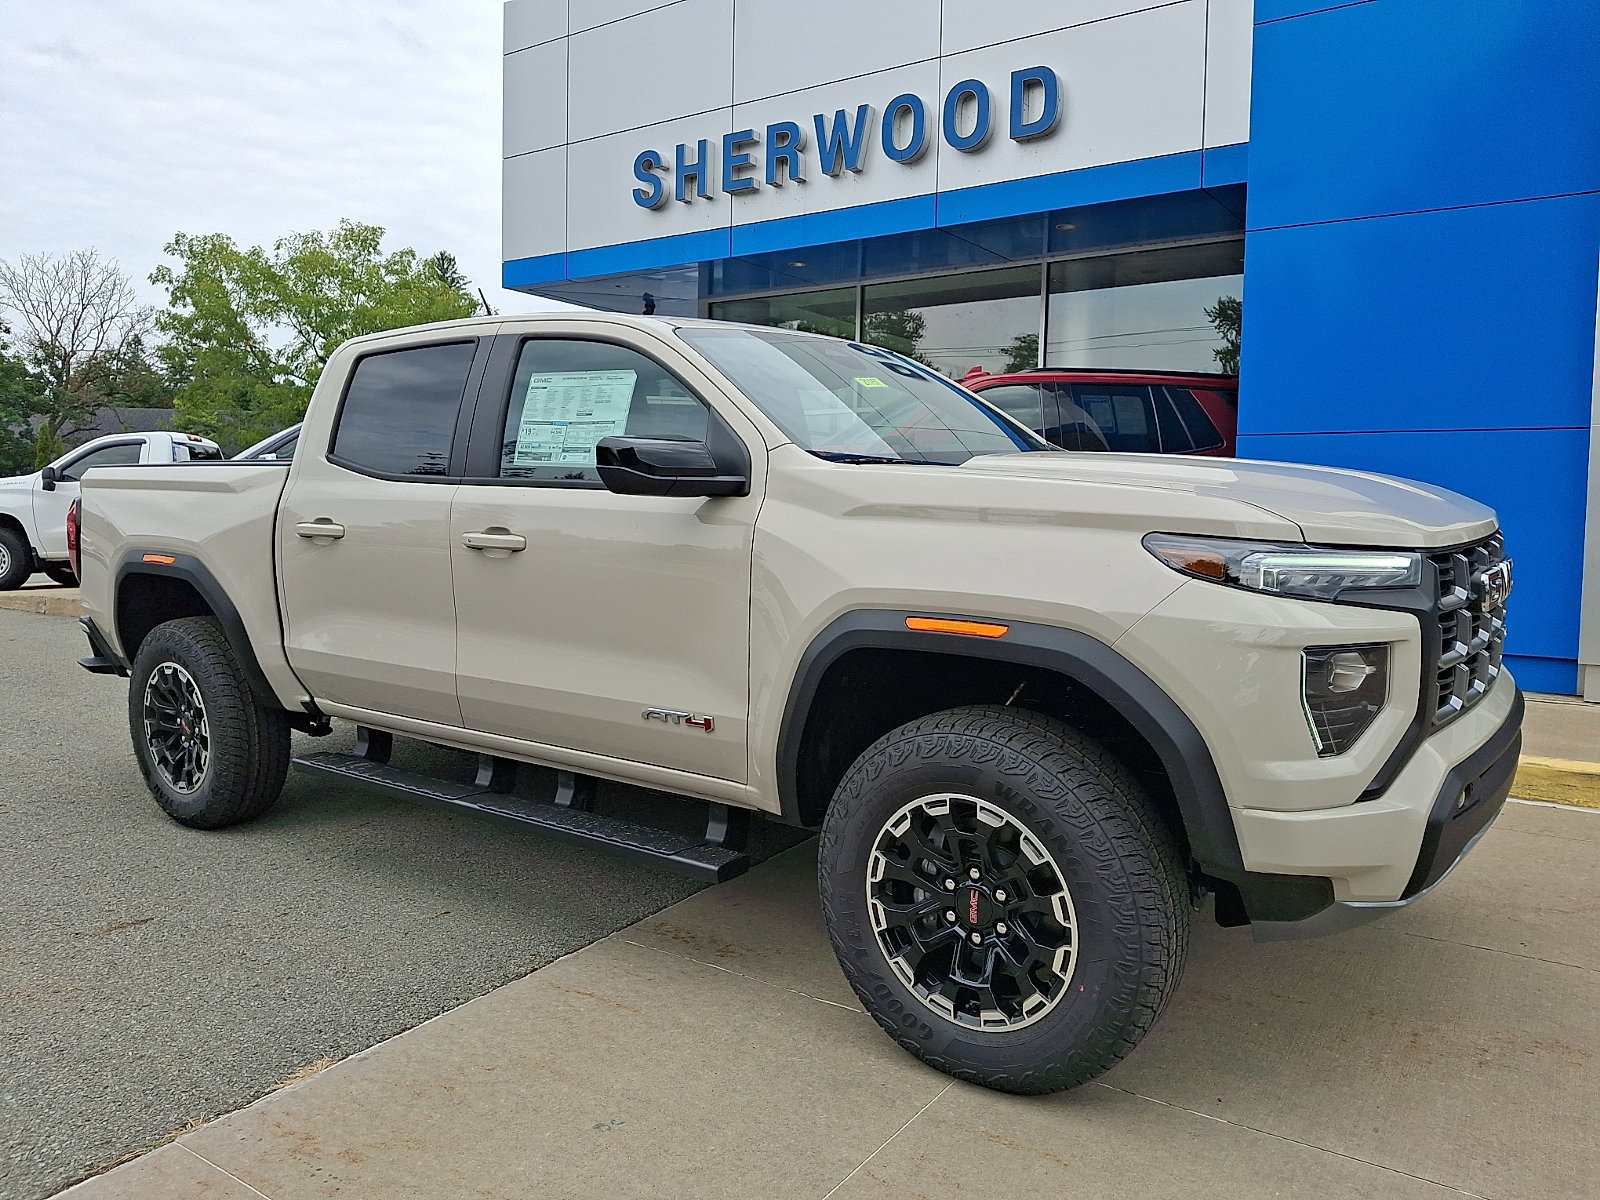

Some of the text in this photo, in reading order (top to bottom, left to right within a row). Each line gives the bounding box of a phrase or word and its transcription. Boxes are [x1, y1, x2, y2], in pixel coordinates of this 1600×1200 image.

[632, 65, 1062, 210] SHERWOOD
[641, 706, 716, 733] AT4
[969, 889, 979, 924] GMC
